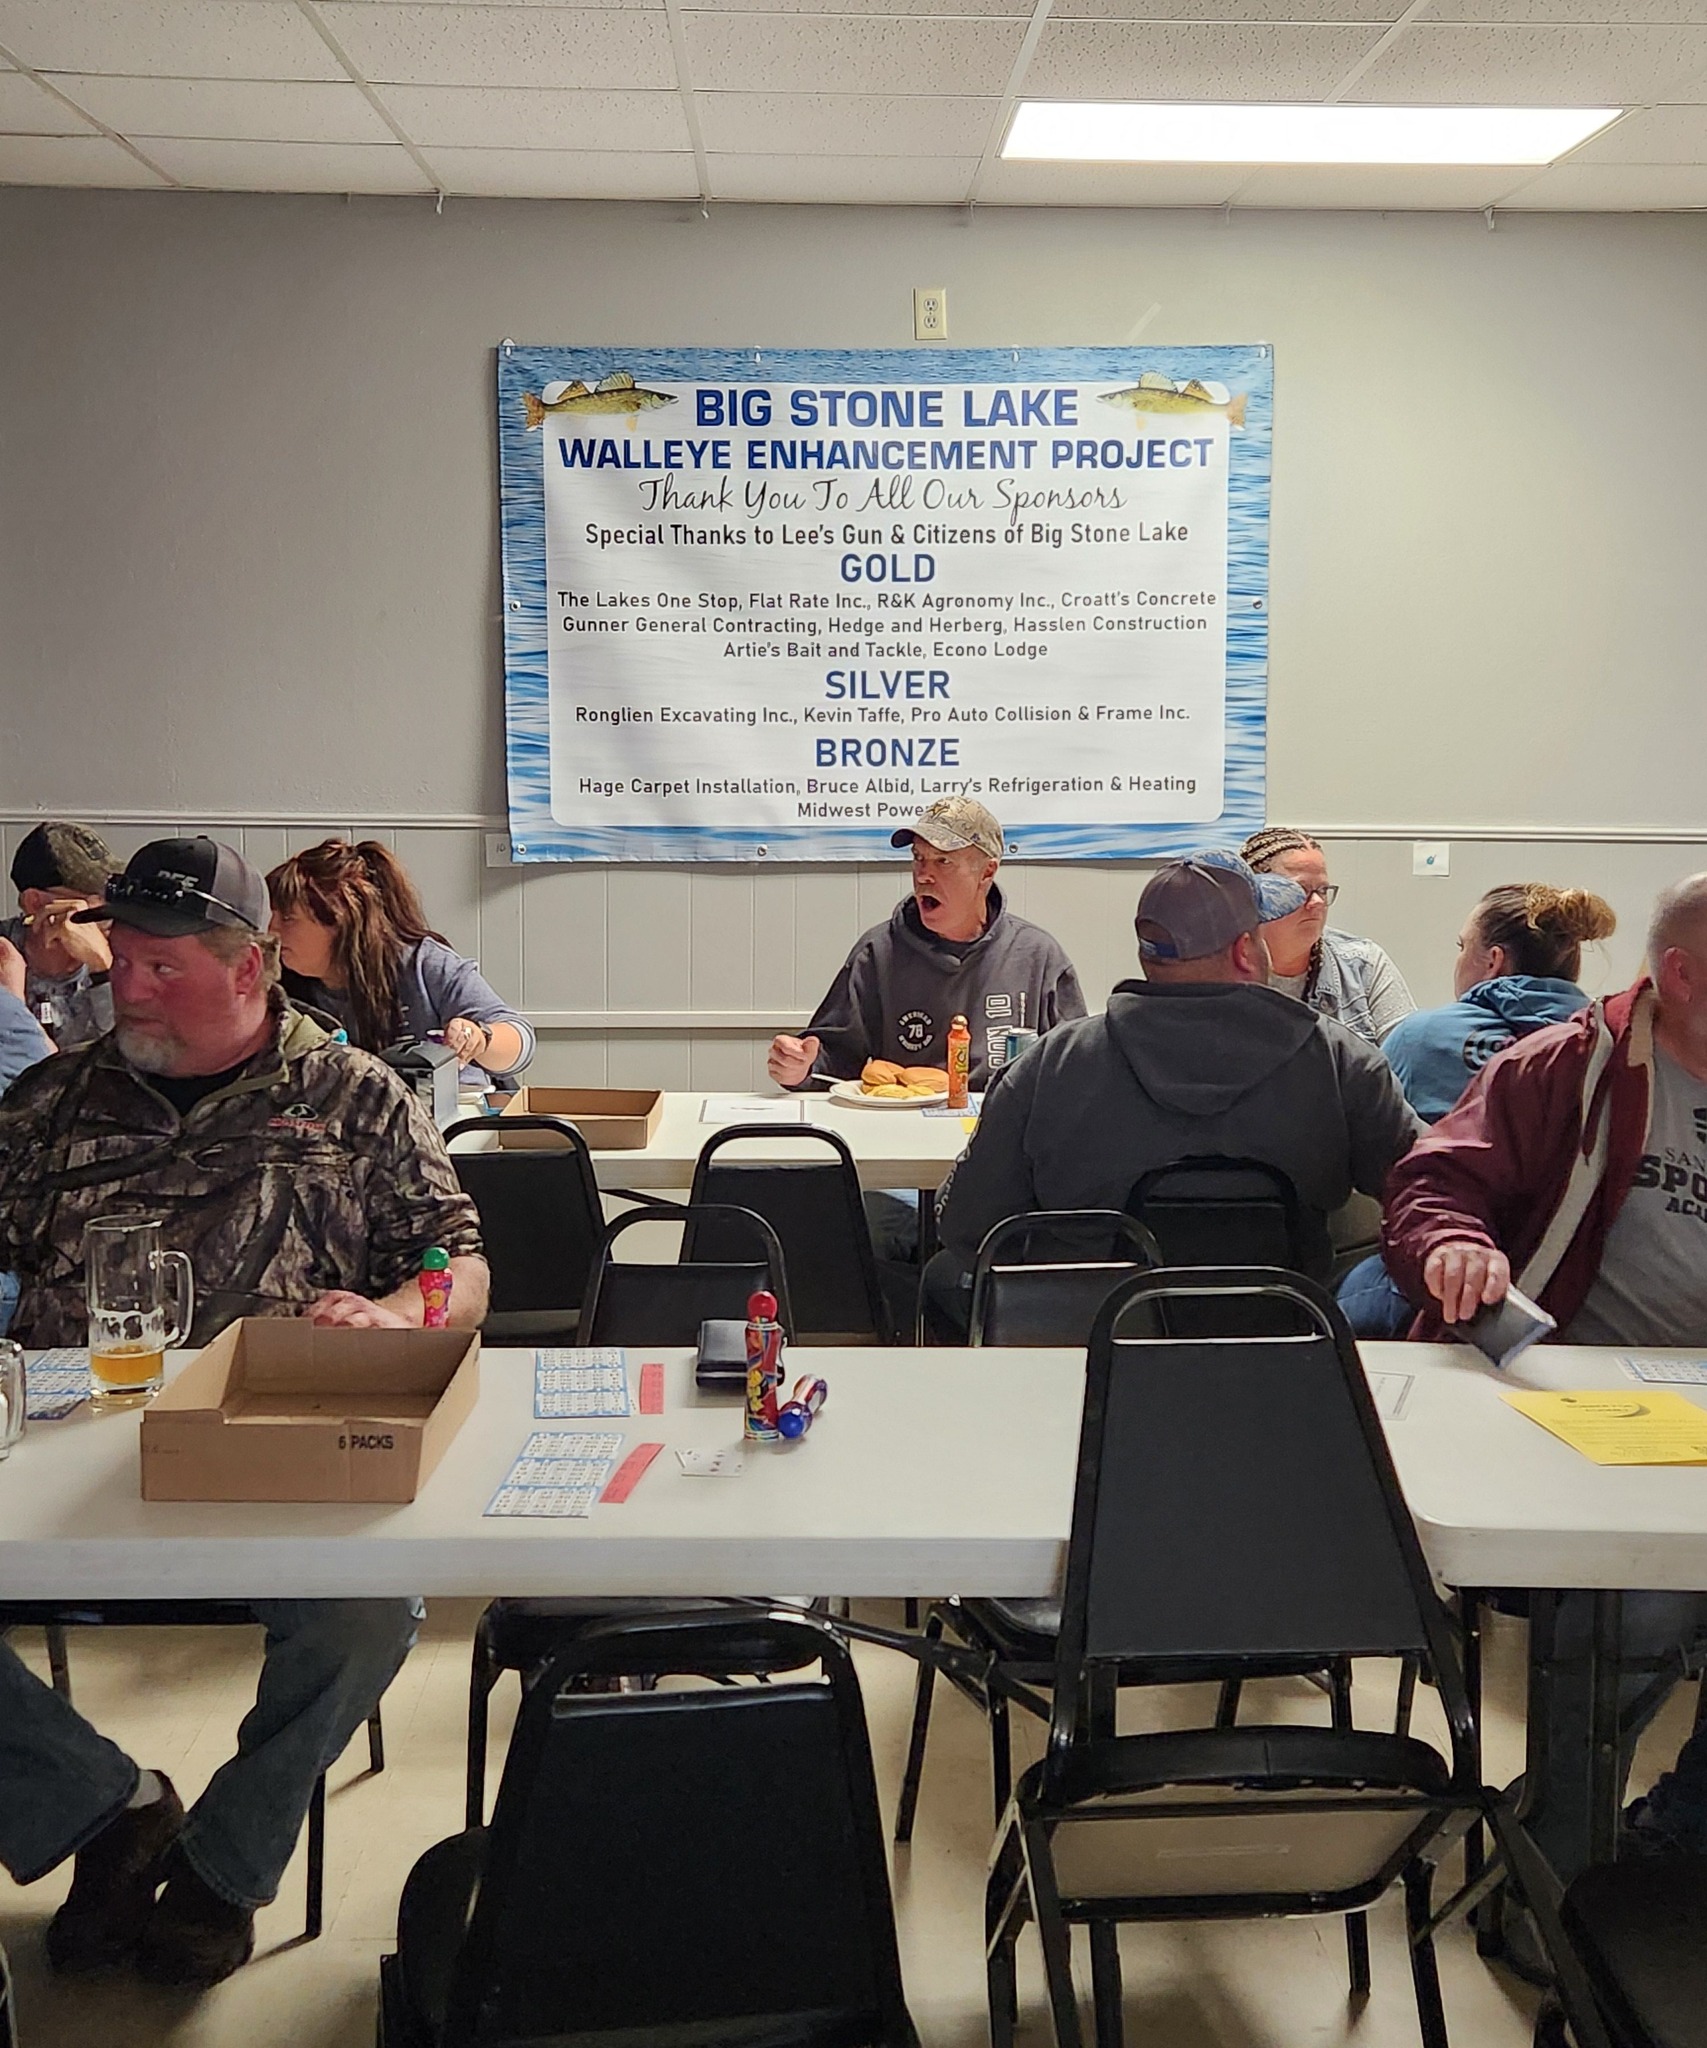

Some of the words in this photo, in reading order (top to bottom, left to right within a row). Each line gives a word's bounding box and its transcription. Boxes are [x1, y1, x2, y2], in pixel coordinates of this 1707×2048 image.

[696, 389, 772, 426] BIG
[791, 390, 943, 427] STONE
[964, 389, 1078, 427] LAKE
[558, 438, 731, 469] WALLEYE
[748, 440, 1037, 469] ENHANCEMENT
[1052, 439, 1213, 468] PROJECT
[639, 472, 733, 513] Thank
[745, 481, 806, 519] You
[813, 478, 849, 513] To
[856, 475, 915, 513] All
[923, 479, 984, 511] Our
[993, 479, 1126, 526] Sponsors
[586, 524, 664, 549] Special
[670, 524, 746, 544] Thanks
[754, 525, 773, 544] to
[783, 524, 834, 544] Lee's
[843, 524, 882, 544] Gun
[891, 524, 905, 544] &
[914, 524, 996, 544] Citizens
[1005, 523, 1023, 543] of
[1032, 523, 1062, 548] Big
[1071, 523, 1129, 542] Stone
[1140, 521, 1187, 541] Lake
[841, 554, 934, 582] GOLD
[558, 592, 589, 607] The
[597, 592, 650, 607] Lakes
[657, 593, 691, 608] One
[698, 593, 742, 612] Stop,
[750, 593, 782, 608] Flat
[790, 593, 829, 608] Rate
[836, 593, 870, 610] Inc.,
[878, 593, 916, 608] R&K
[922, 593, 1013, 612] Agronomy
[1021, 593, 1054, 609] Inc.,
[1062, 591, 1129, 607] Croatt's
[1137, 591, 1215, 605] Concrete
[563, 616, 629, 631] Gunner
[636, 617, 706, 632] General
[714, 617, 821, 636] Contracting,
[829, 617, 884, 636] Hedge
[891, 617, 922, 632] and
[930, 617, 1007, 635] Herberg,
[1014, 617, 1085, 632] Hasslen
[1094, 615, 1206, 630] Construction
[724, 642, 780, 657] Artie's
[788, 642, 821, 657] Bait
[828, 642, 859, 657] and
[865, 642, 926, 659] Tackle,
[934, 642, 987, 656] Econo
[995, 642, 1047, 660] Lodge
[825, 671, 950, 699] SILVER
[576, 707, 653, 725] Ronglien
[661, 707, 756, 726] Excavating
[763, 707, 797, 725] Inc.,
[805, 707, 852, 722] Kevin
[857, 707, 904, 724] Taffe,
[912, 707, 940, 722] Pro
[948, 707, 988, 721] Auto
[995, 706, 1071, 721] Collision
[1078, 706, 1089, 720] &
[1097, 706, 1152, 720] Frame
[1160, 705, 1189, 719] Inc.
[817, 739, 959, 767] BRONZE
[580, 778, 624, 797] Hage
[632, 778, 689, 797] Carpet
[697, 778, 800, 796] Installation,
[807, 779, 858, 793] Bruce
[865, 778, 914, 795] Albid,
[989, 777, 1103, 795] Refrigeration
[1111, 776, 1121, 790] &
[1130, 776, 1195, 794] Heating
[798, 802, 870, 817] Midwest
[878, 802, 930, 818] Powe
[985, 994, 1012, 1019] 10
[1632, 1155, 1707, 1203] SPO
[339, 1435, 347, 1449] 6
[351, 1435, 394, 1449] PACKS
